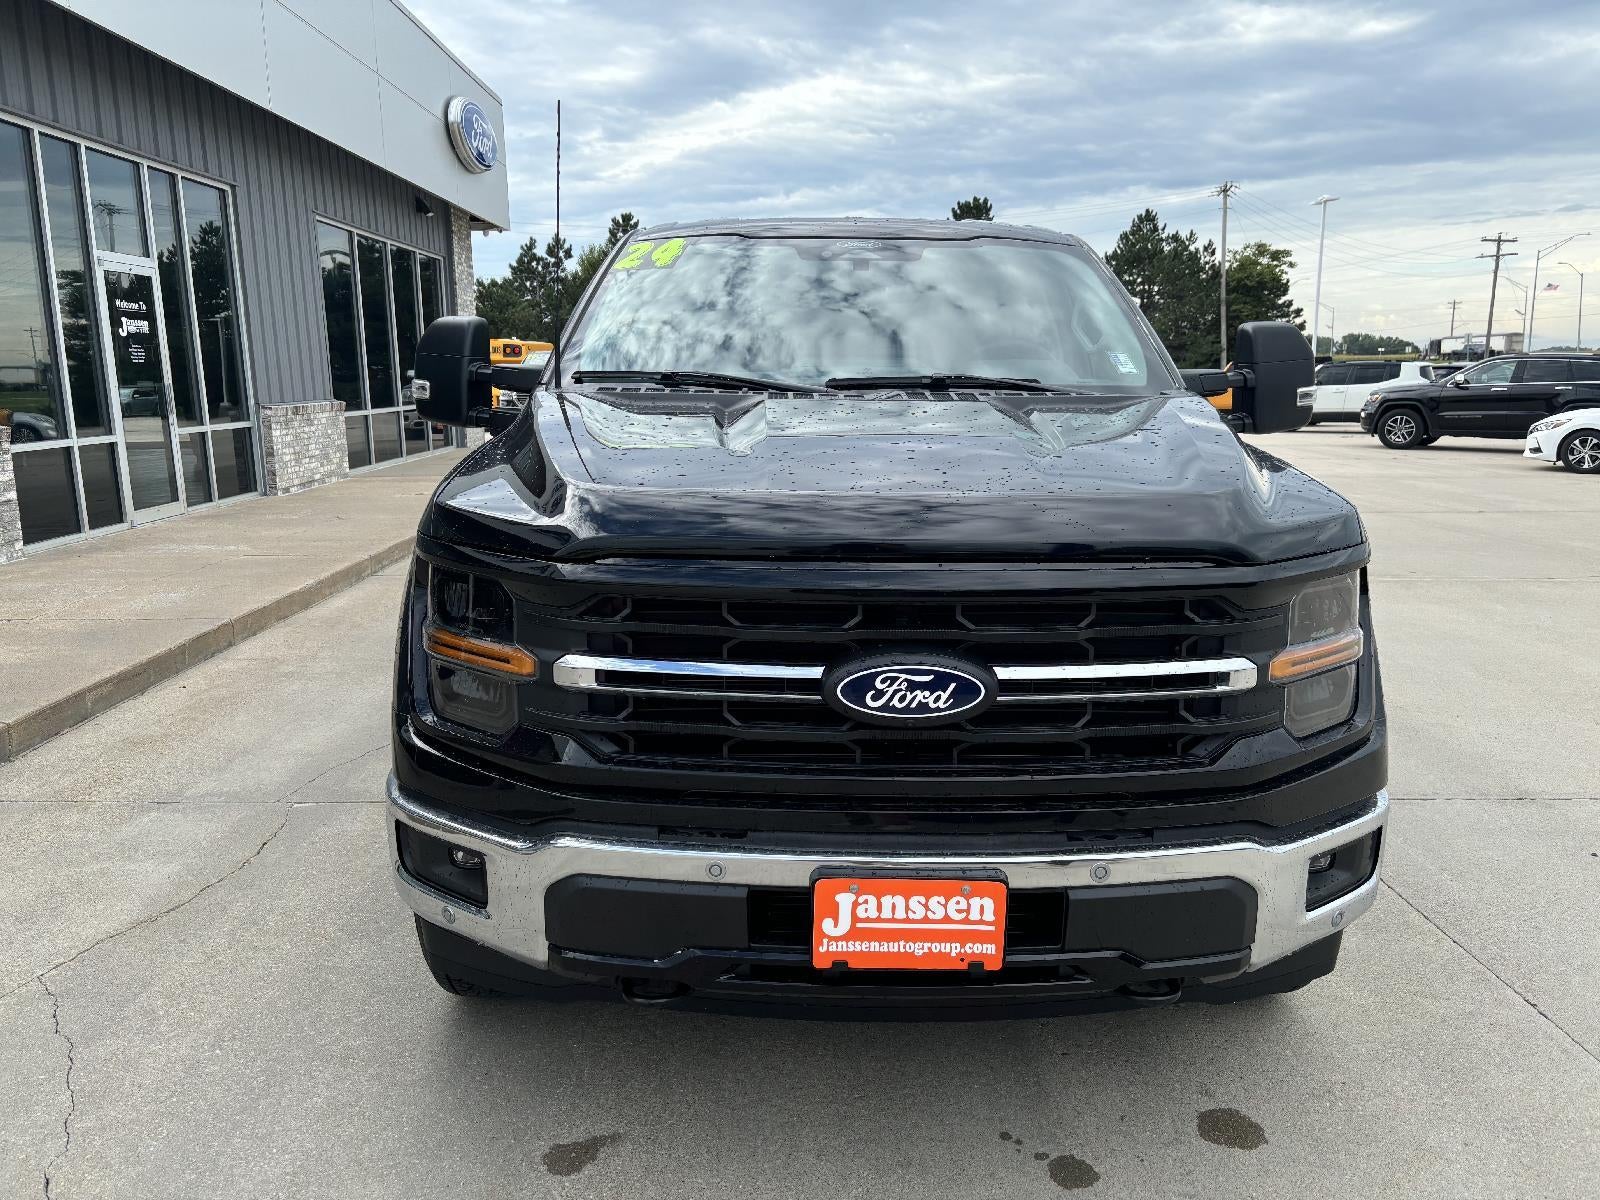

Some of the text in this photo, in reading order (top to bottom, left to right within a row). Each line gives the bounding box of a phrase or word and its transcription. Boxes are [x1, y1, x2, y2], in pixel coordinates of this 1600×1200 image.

[471, 113, 493, 158] Ford
[613, 238, 686, 269] 24
[115, 298, 147, 311] Welcome To
[119, 316, 149, 336] Janssen
[865, 672, 957, 709] Ford
[821, 892, 996, 937] Janssen
[818, 938, 996, 956] Janssenautogroup.com
